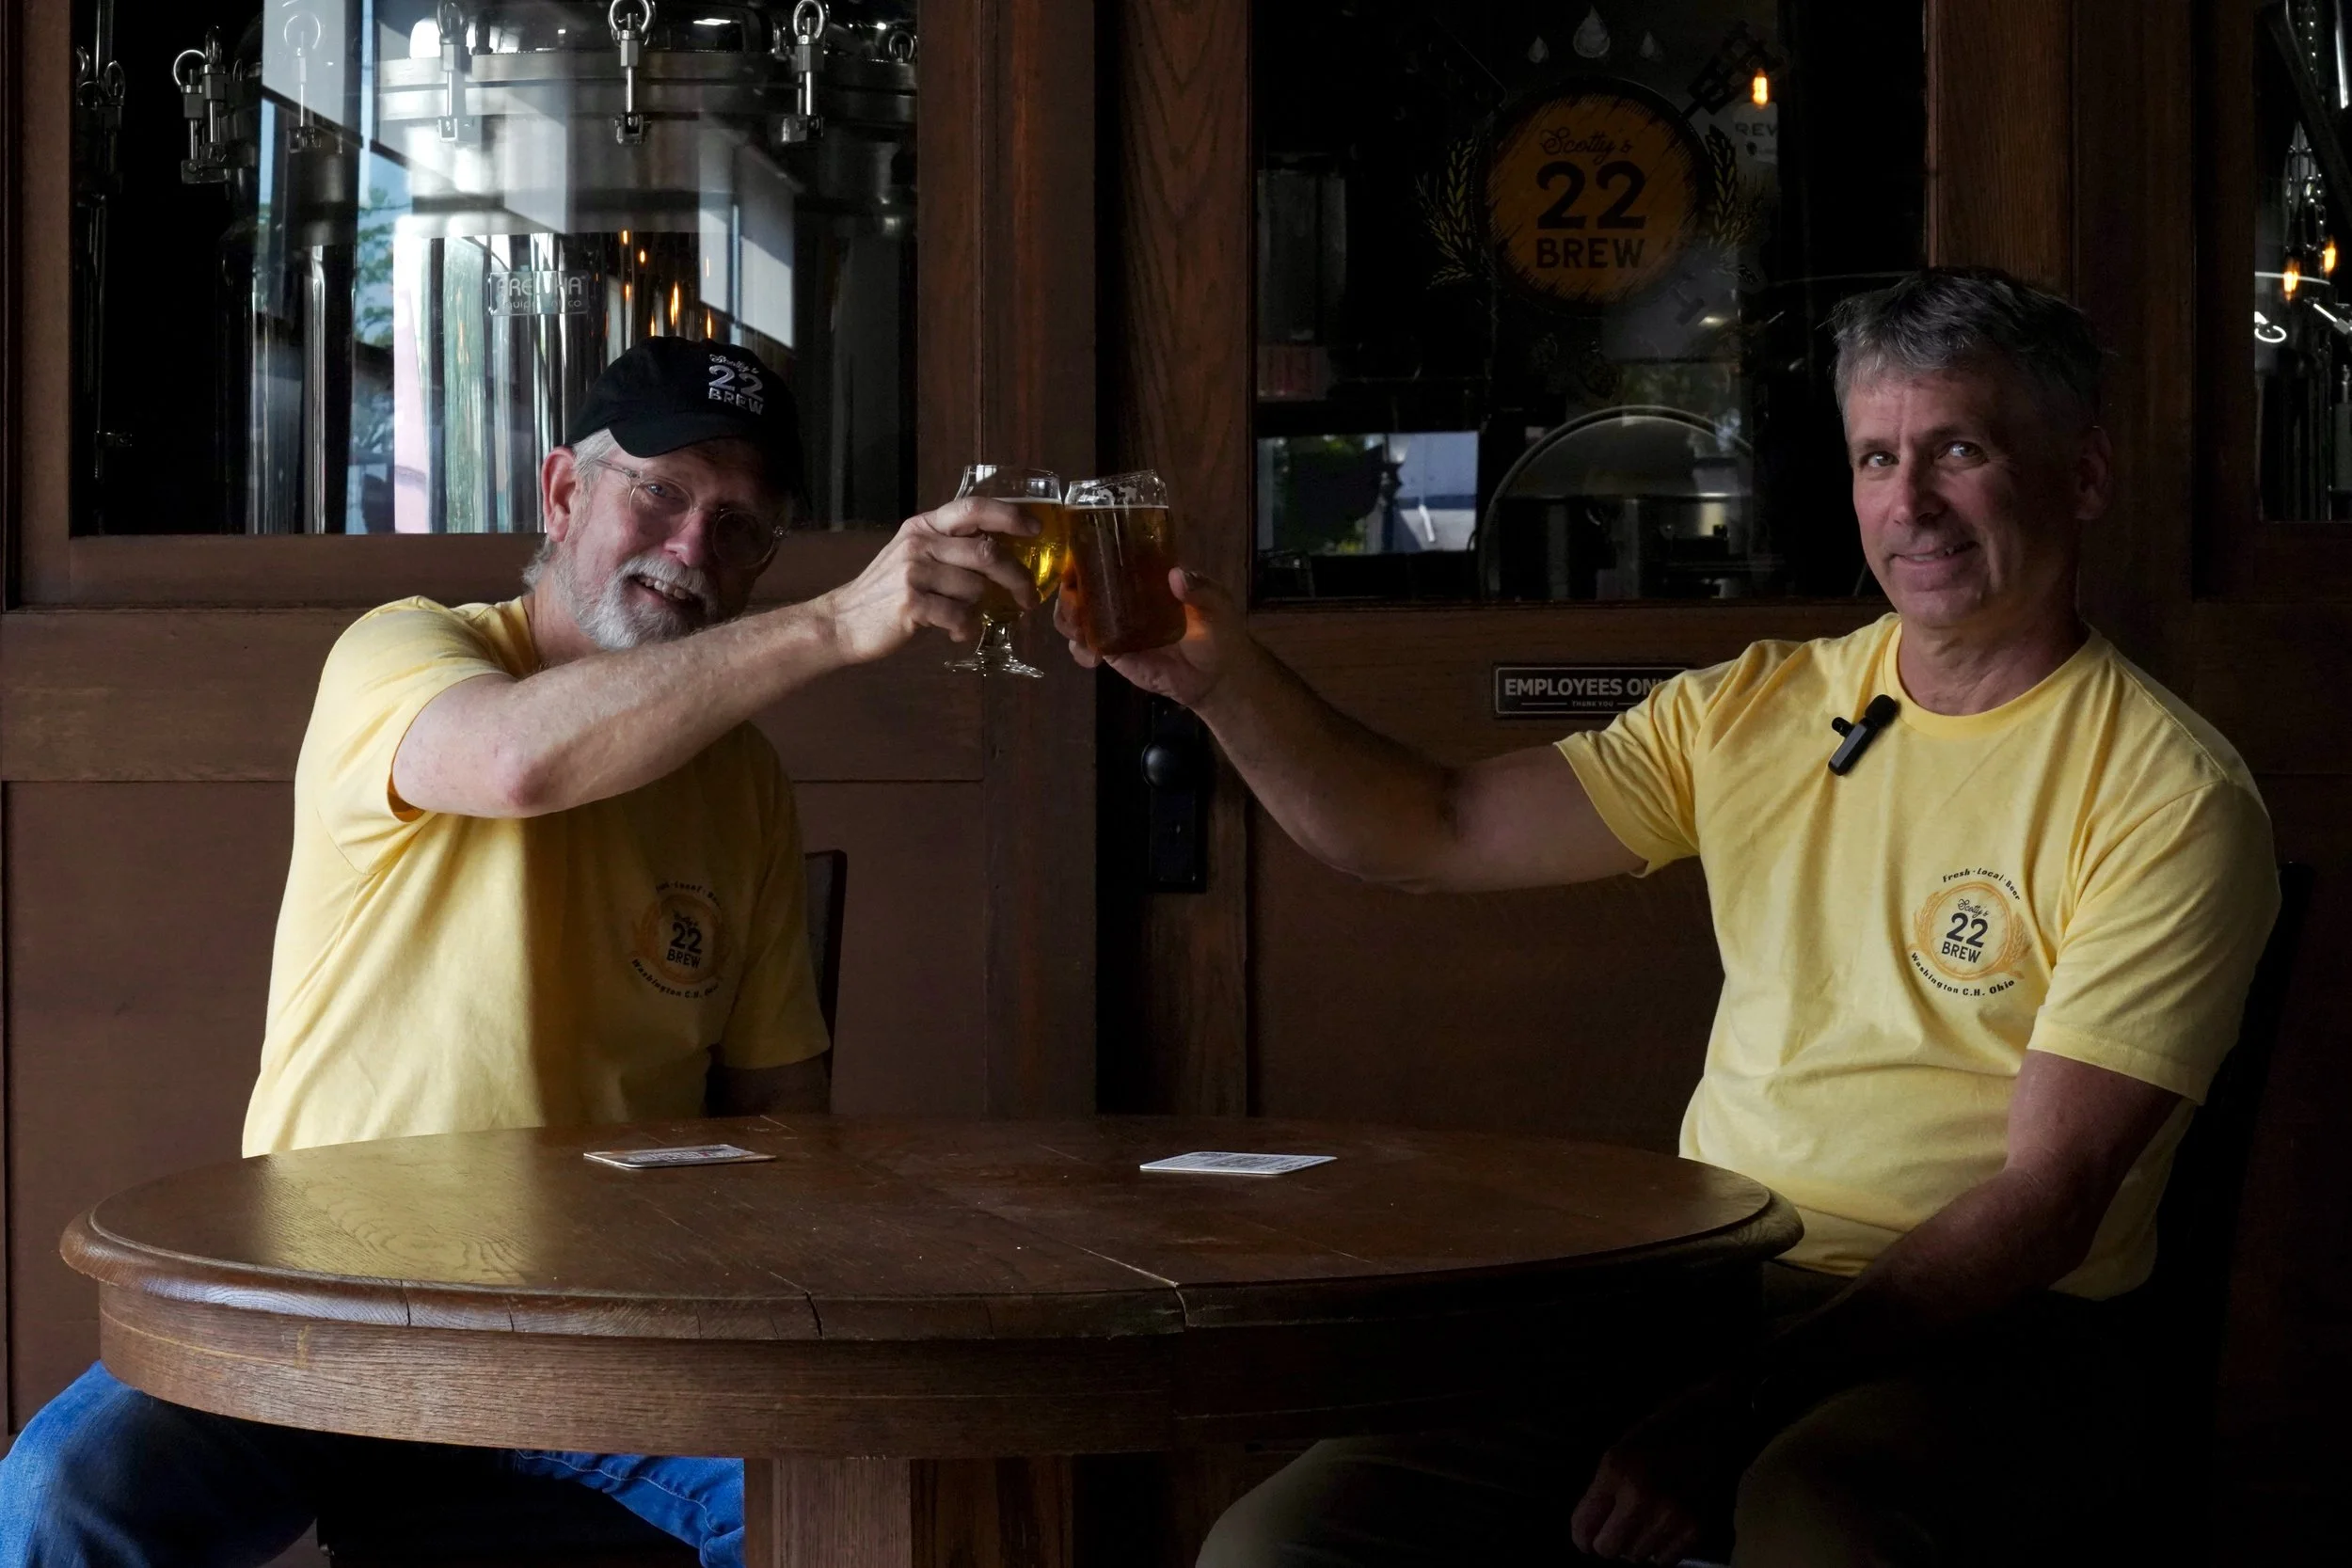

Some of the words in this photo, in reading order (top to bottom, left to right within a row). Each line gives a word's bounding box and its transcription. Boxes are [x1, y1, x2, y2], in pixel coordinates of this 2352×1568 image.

[1540, 127, 1633, 166] Scotty's
[1536, 161, 1646, 229] 22
[1536, 237, 1645, 268] BREW
[708, 364, 764, 403] 22
[707, 387, 764, 416] BREW
[1505, 677, 1622, 696] EMPLOYEES
[1942, 868, 1970, 882] Fresh
[1977, 867, 2005, 881] Local
[2005, 879, 2021, 900] Beer
[1957, 898, 1990, 918] Scotty's
[671, 923, 702, 954] 22
[1946, 912, 1988, 948] 22
[667, 949, 701, 970] BREW
[1941, 942, 1981, 963] BREW
[1911, 952, 1959, 994] Washington
[1989, 979, 2015, 994] Ohio
